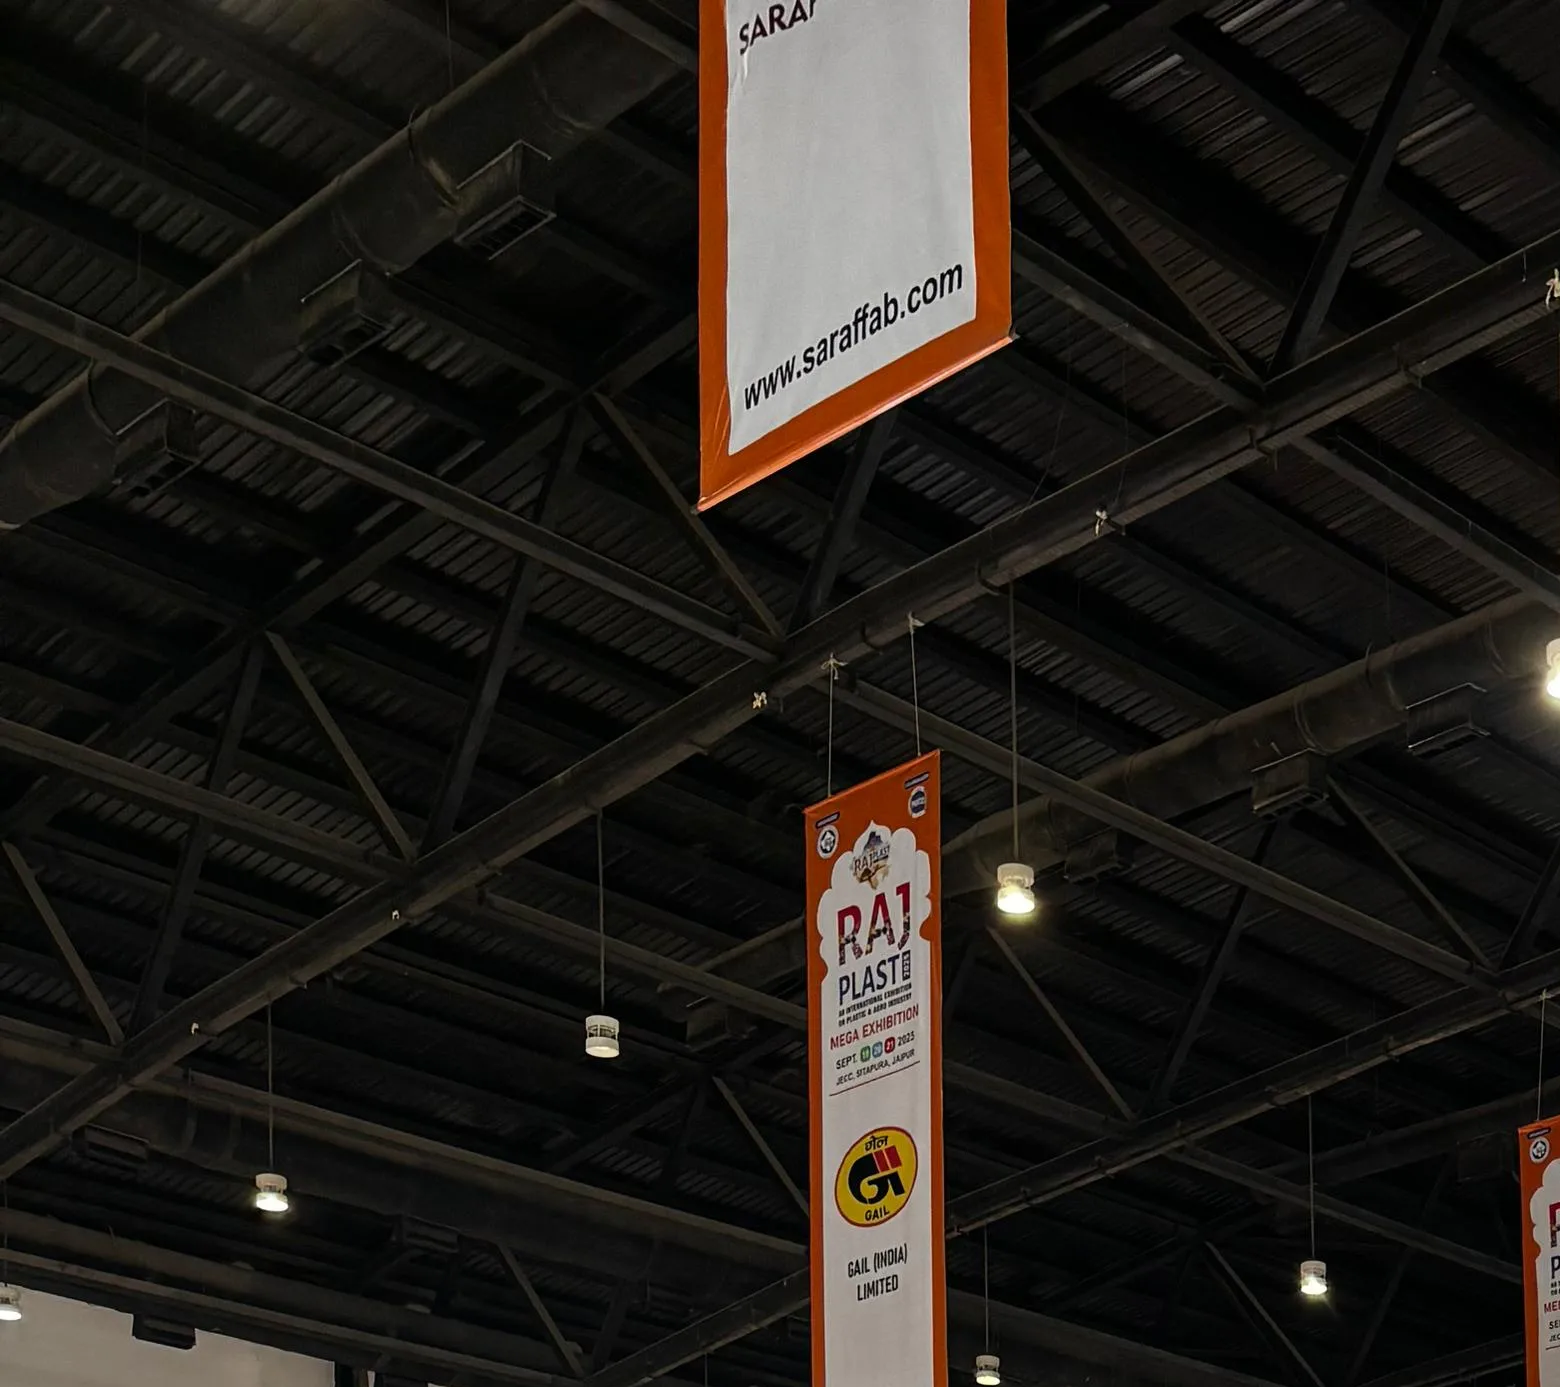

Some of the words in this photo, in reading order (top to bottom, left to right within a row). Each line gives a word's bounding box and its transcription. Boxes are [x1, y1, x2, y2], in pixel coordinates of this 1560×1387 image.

[744, 263, 963, 410] www.saraffab.com
[837, 881, 911, 966] RAJ
[838, 954, 900, 1005] PLAST
[830, 1026, 860, 1050] MEGA
[862, 1004, 919, 1040] EXHIBITION
[864, 1205, 890, 1222] GAIL
[848, 1254, 871, 1279] GAIL
[873, 1242, 908, 1274] (INDIA)
[857, 1274, 899, 1301] LIMITED
